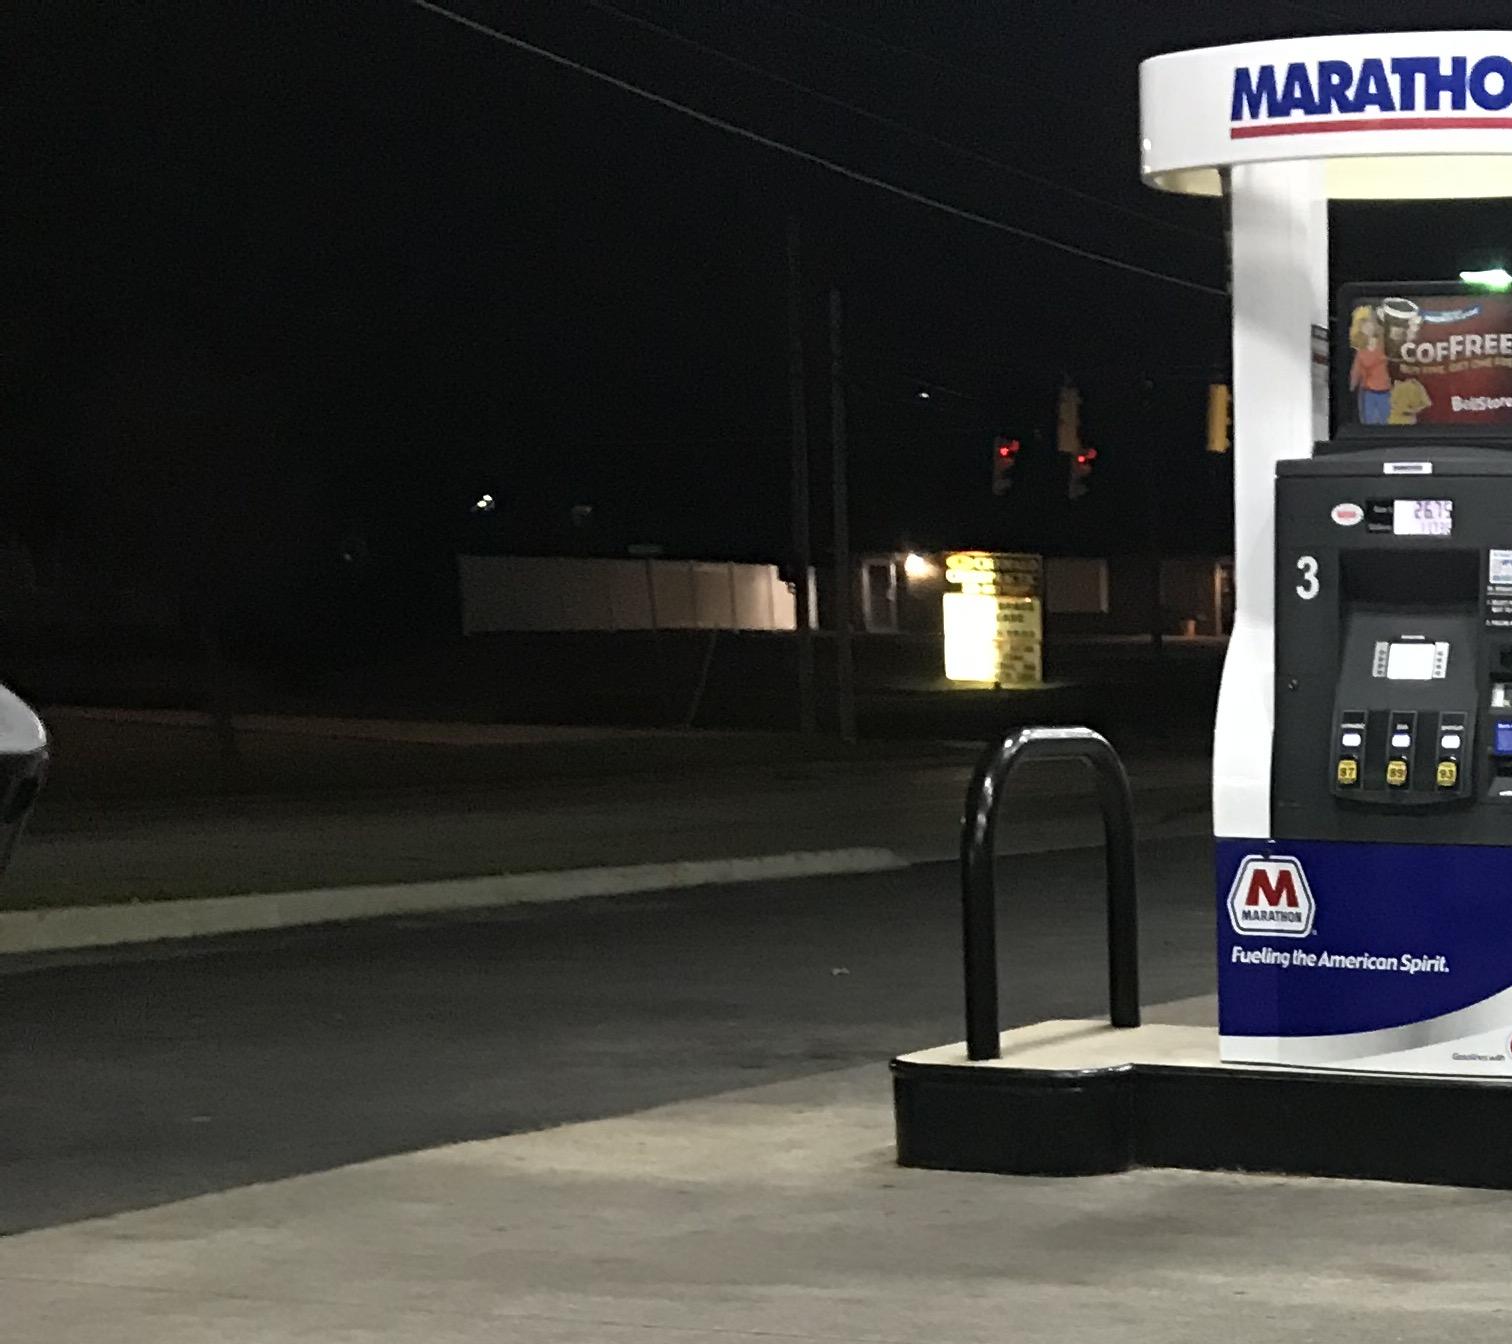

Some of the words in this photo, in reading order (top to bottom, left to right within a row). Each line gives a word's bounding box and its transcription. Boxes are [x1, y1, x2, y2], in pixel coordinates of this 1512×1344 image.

[1296, 556, 1320, 600] 3
[1245, 869, 1299, 908] M
[1242, 910, 1302, 923] MARATHON
[1231, 946, 1290, 968] Fueling
[1292, 949, 1316, 966] the
[1318, 951, 1398, 971] American
[1400, 954, 1449, 974] Spirit.
